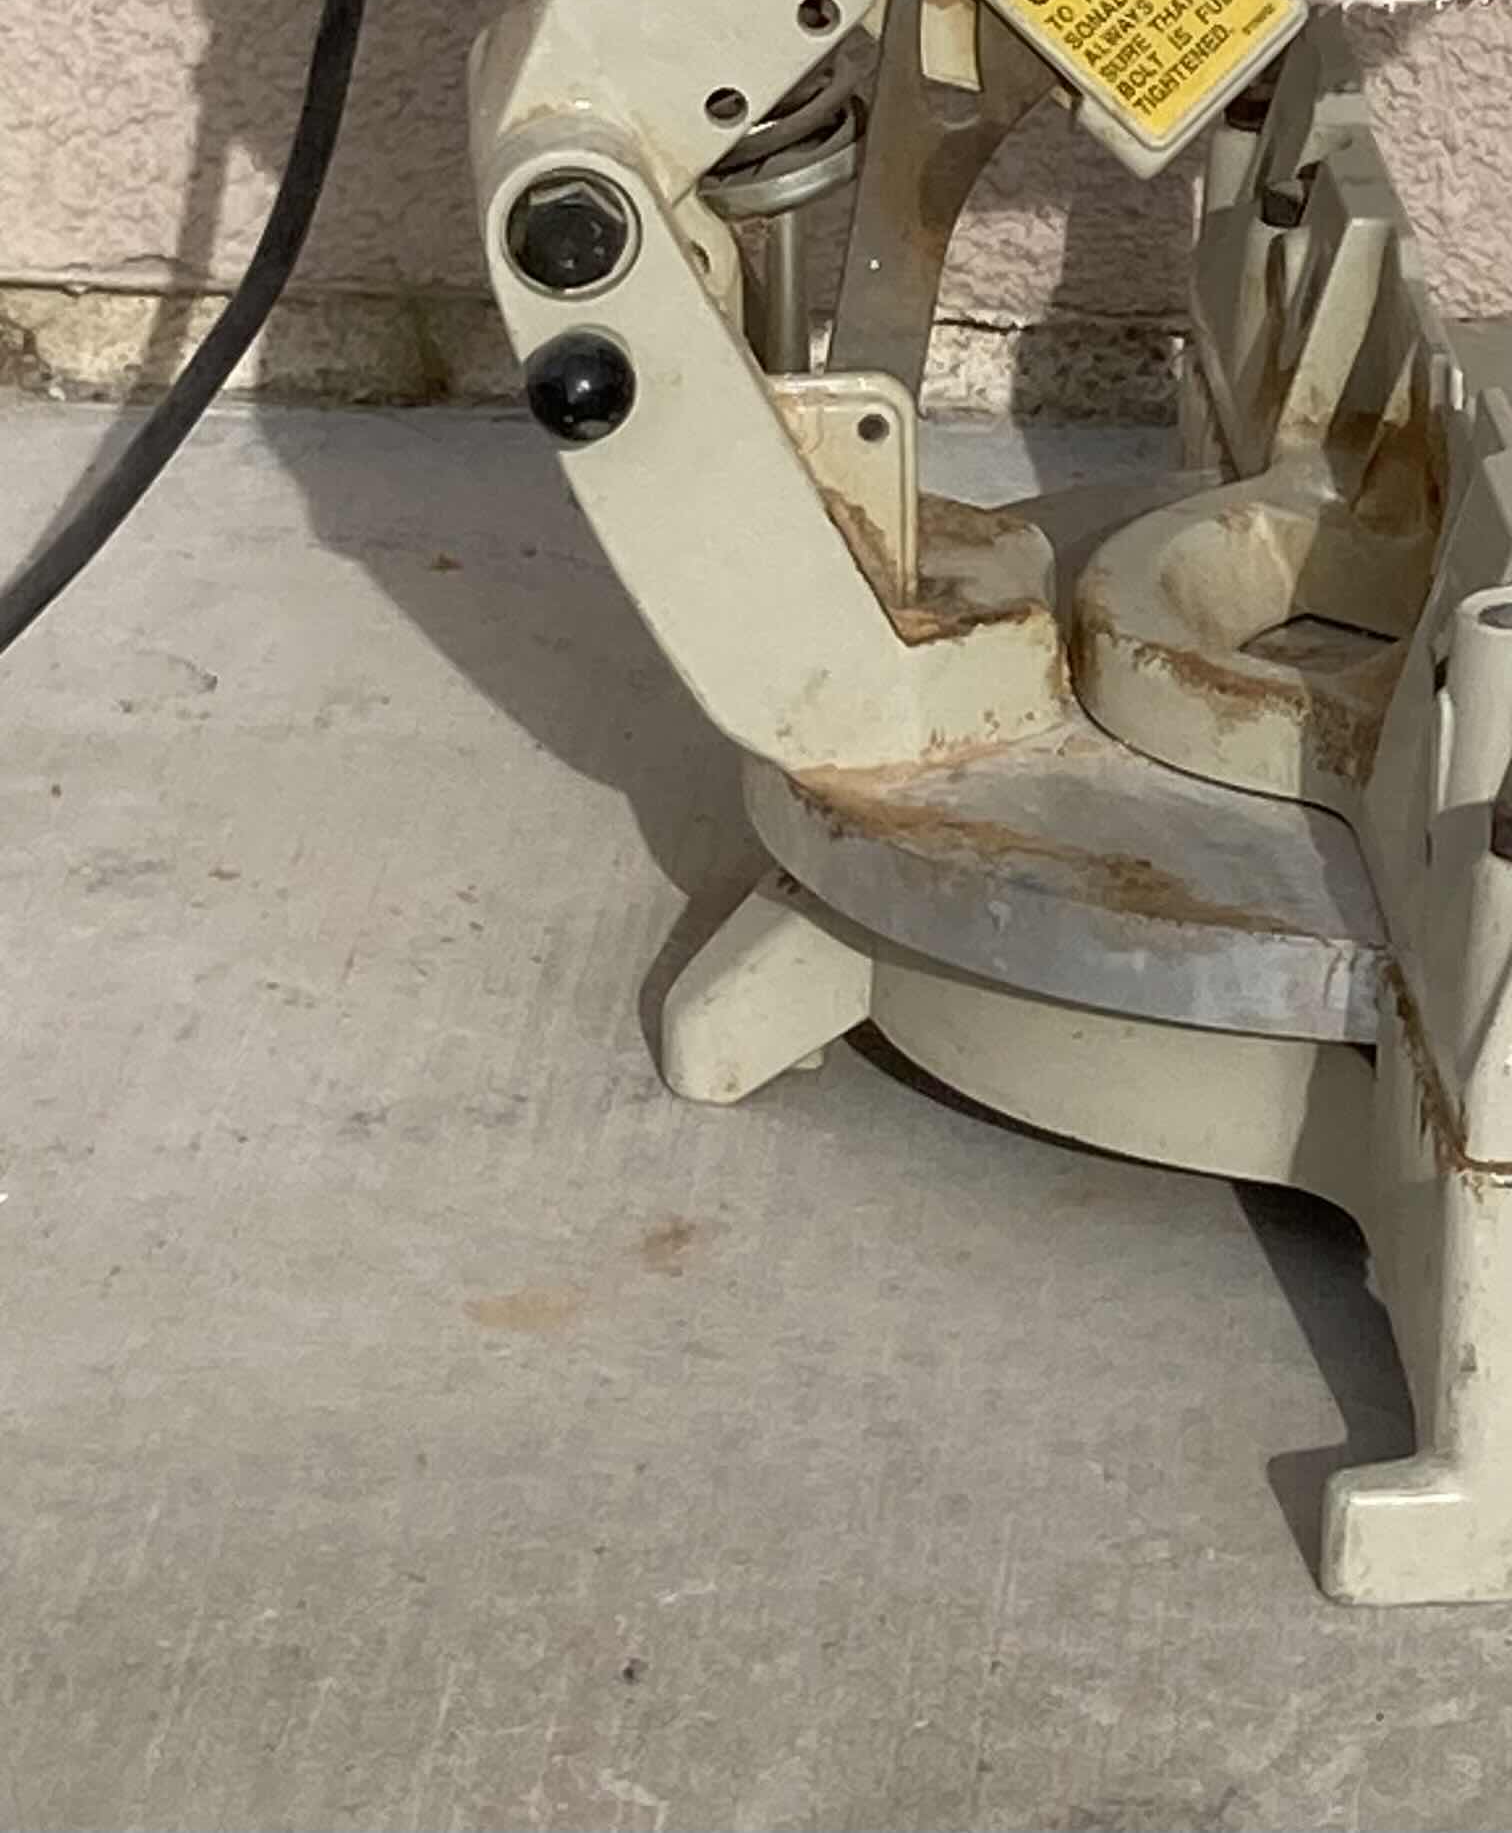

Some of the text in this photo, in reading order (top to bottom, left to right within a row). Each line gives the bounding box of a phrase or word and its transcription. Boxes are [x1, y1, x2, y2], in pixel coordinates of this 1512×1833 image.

[1045, 3, 1076, 33] TO
[1099, 33, 1151, 84] SURE
[1117, 52, 1166, 100] BOLT
[1168, 26, 1193, 51] IS
